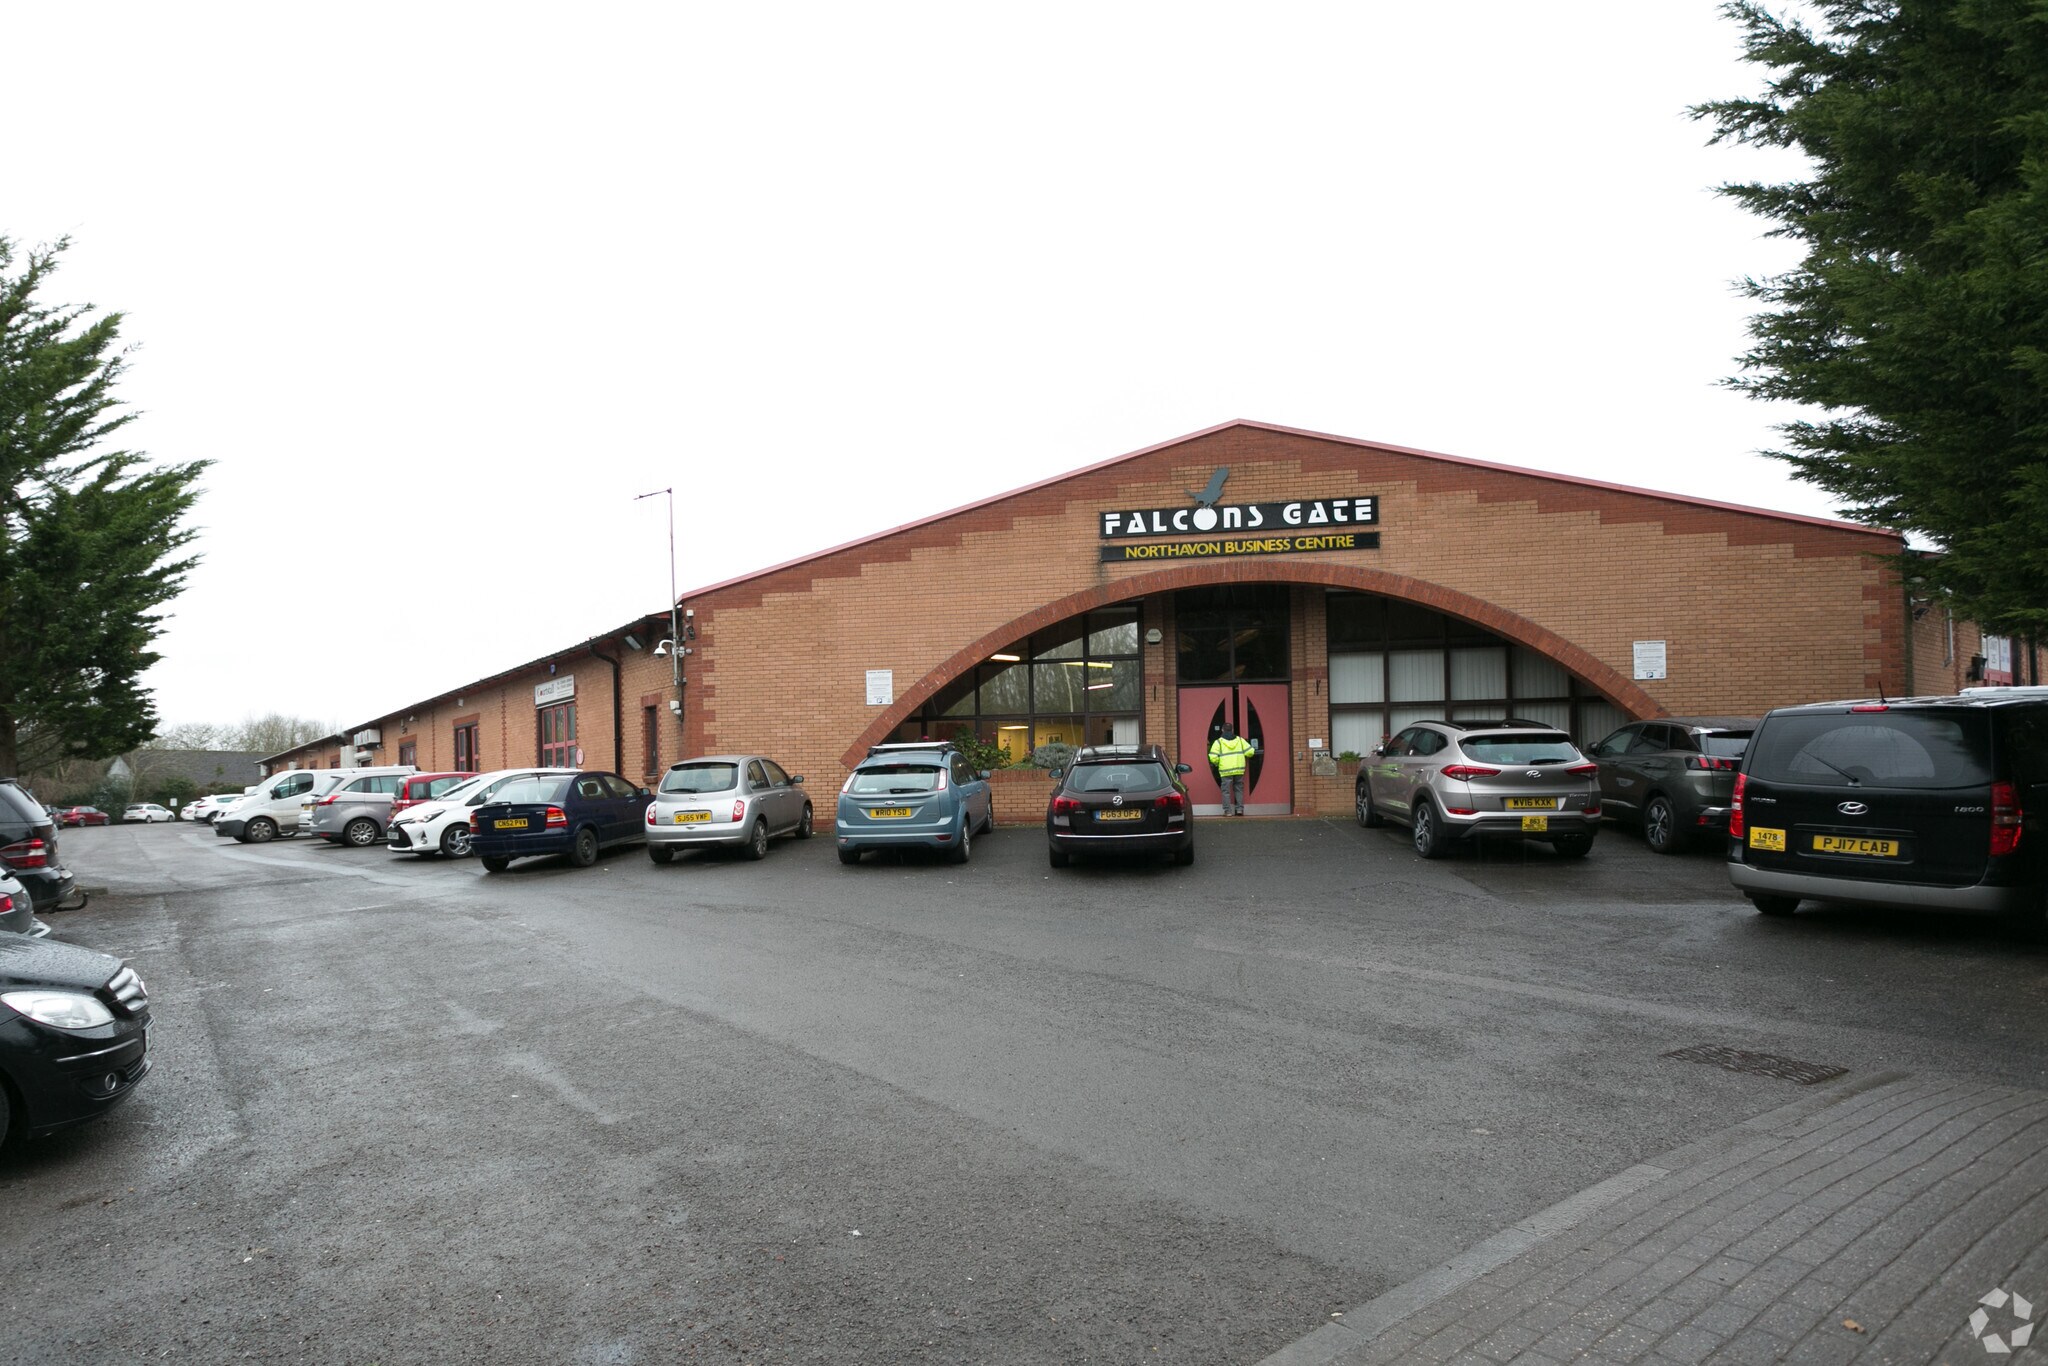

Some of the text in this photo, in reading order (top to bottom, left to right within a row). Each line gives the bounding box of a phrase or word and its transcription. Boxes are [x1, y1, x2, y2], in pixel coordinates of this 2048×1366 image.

[1105, 498, 1372, 535] FALCONS GATE
[1125, 535, 1355, 559] NORTHAVON BUSINESS CENTRE
[1757, 831, 1778, 842] 1478
[1822, 837, 1890, 854] PJ17 CAB
